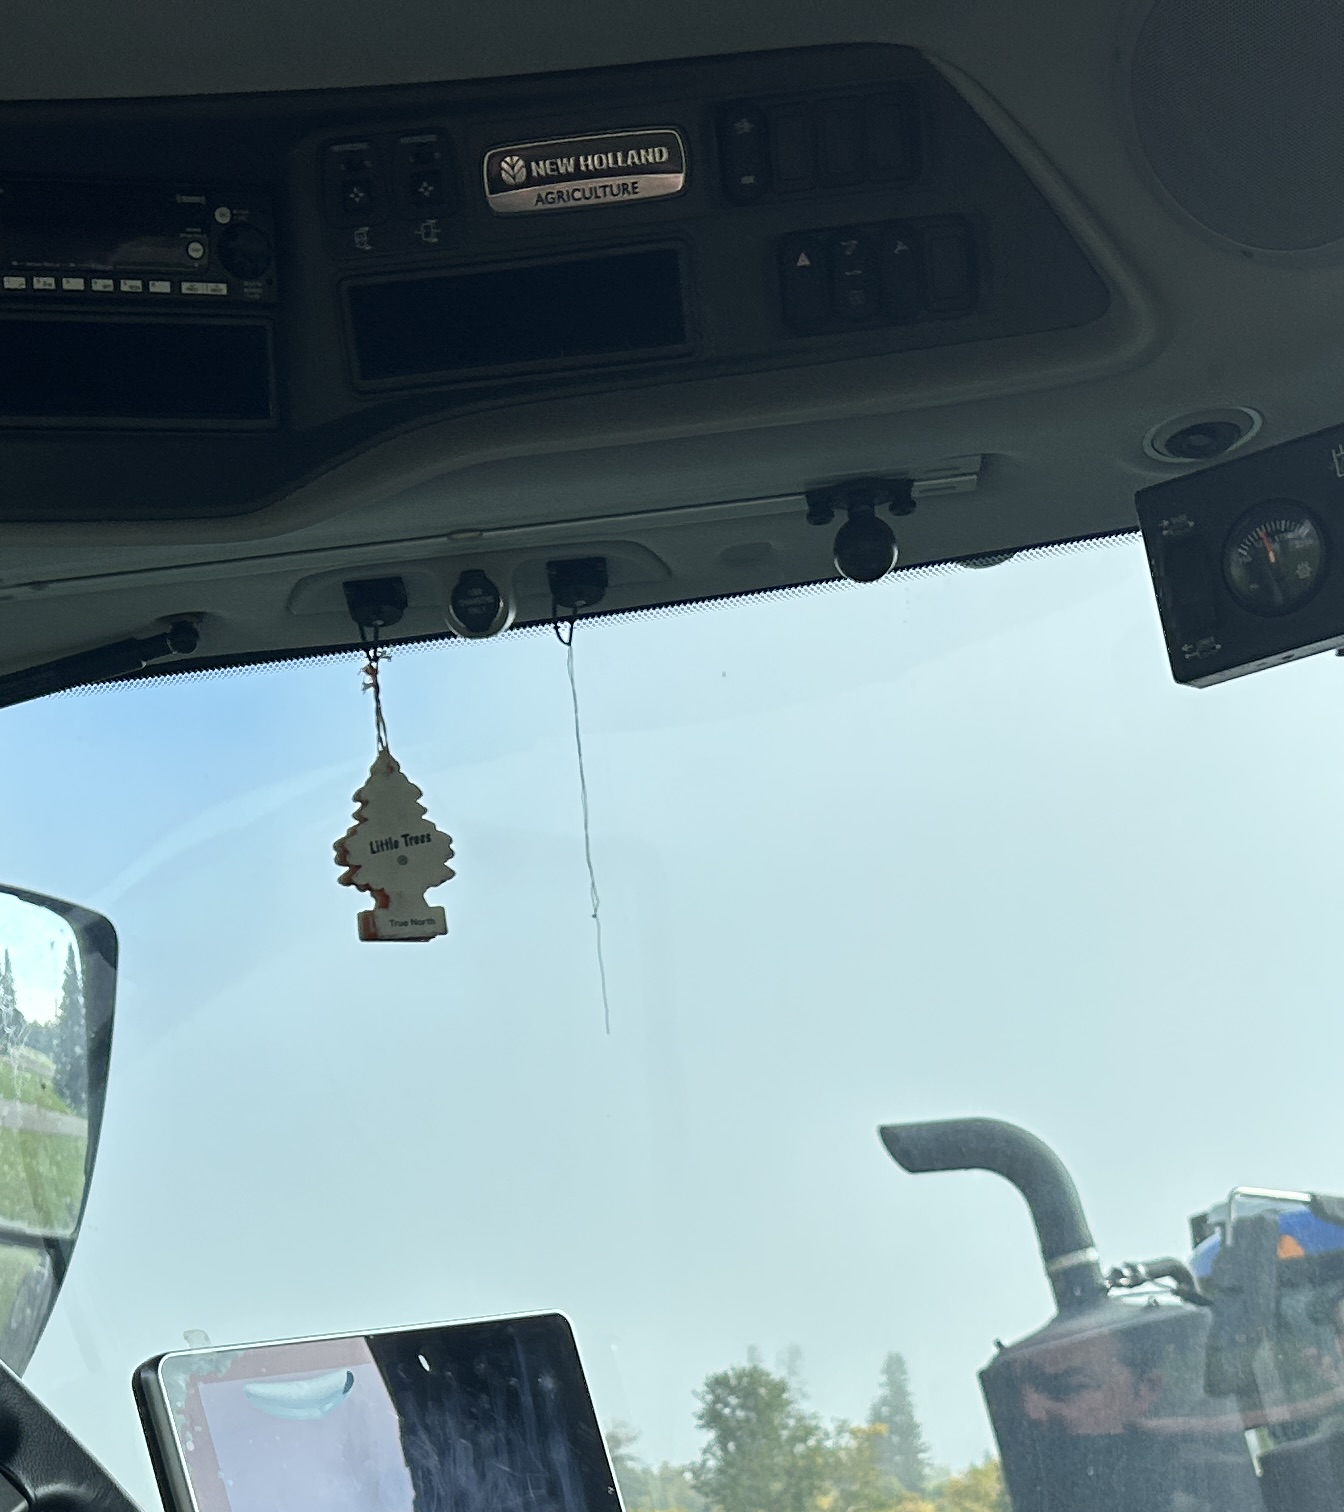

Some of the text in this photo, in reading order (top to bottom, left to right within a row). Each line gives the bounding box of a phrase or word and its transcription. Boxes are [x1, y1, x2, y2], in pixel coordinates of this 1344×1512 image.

[530, 146, 669, 178] NEW HOLLAND
[534, 181, 639, 206] AGRICULTURE
[369, 833, 432, 854] Little Trees
[389, 918, 436, 928] True North
